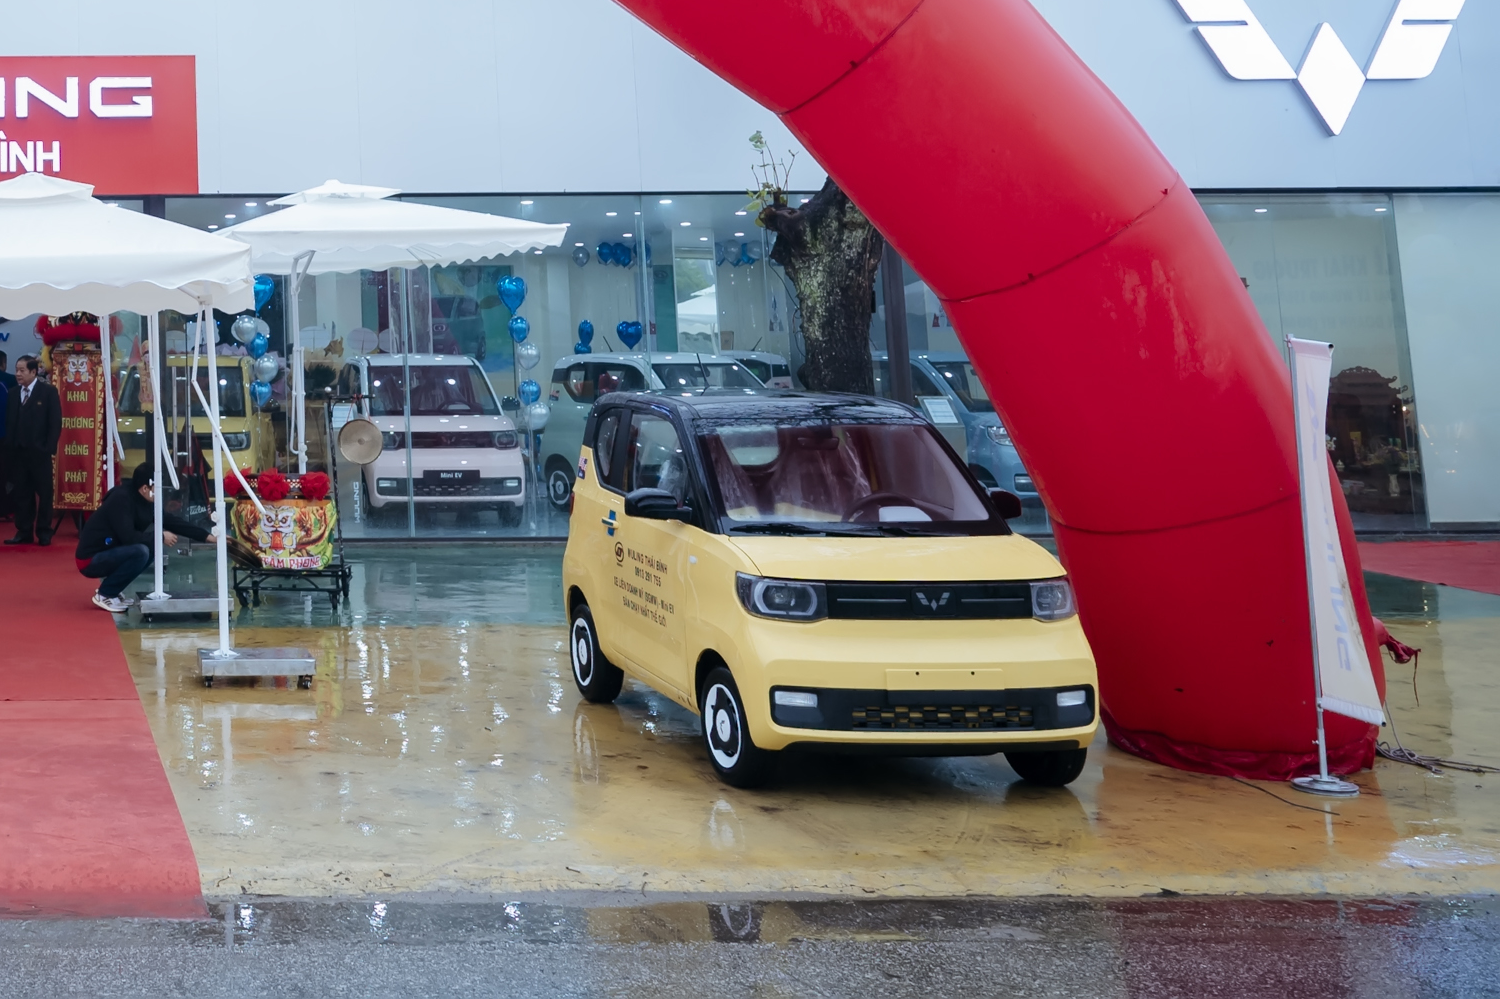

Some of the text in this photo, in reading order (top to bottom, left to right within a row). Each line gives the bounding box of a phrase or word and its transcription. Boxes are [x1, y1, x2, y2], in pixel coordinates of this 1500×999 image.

[66, 390, 88, 402] KHAI
[64, 440, 89, 456] HỒNG
[64, 469, 88, 483] PHÁT
[353, 481, 361, 524] WULING
[627, 547, 644, 564] WULING
[644, 555, 655, 570] THÁI
